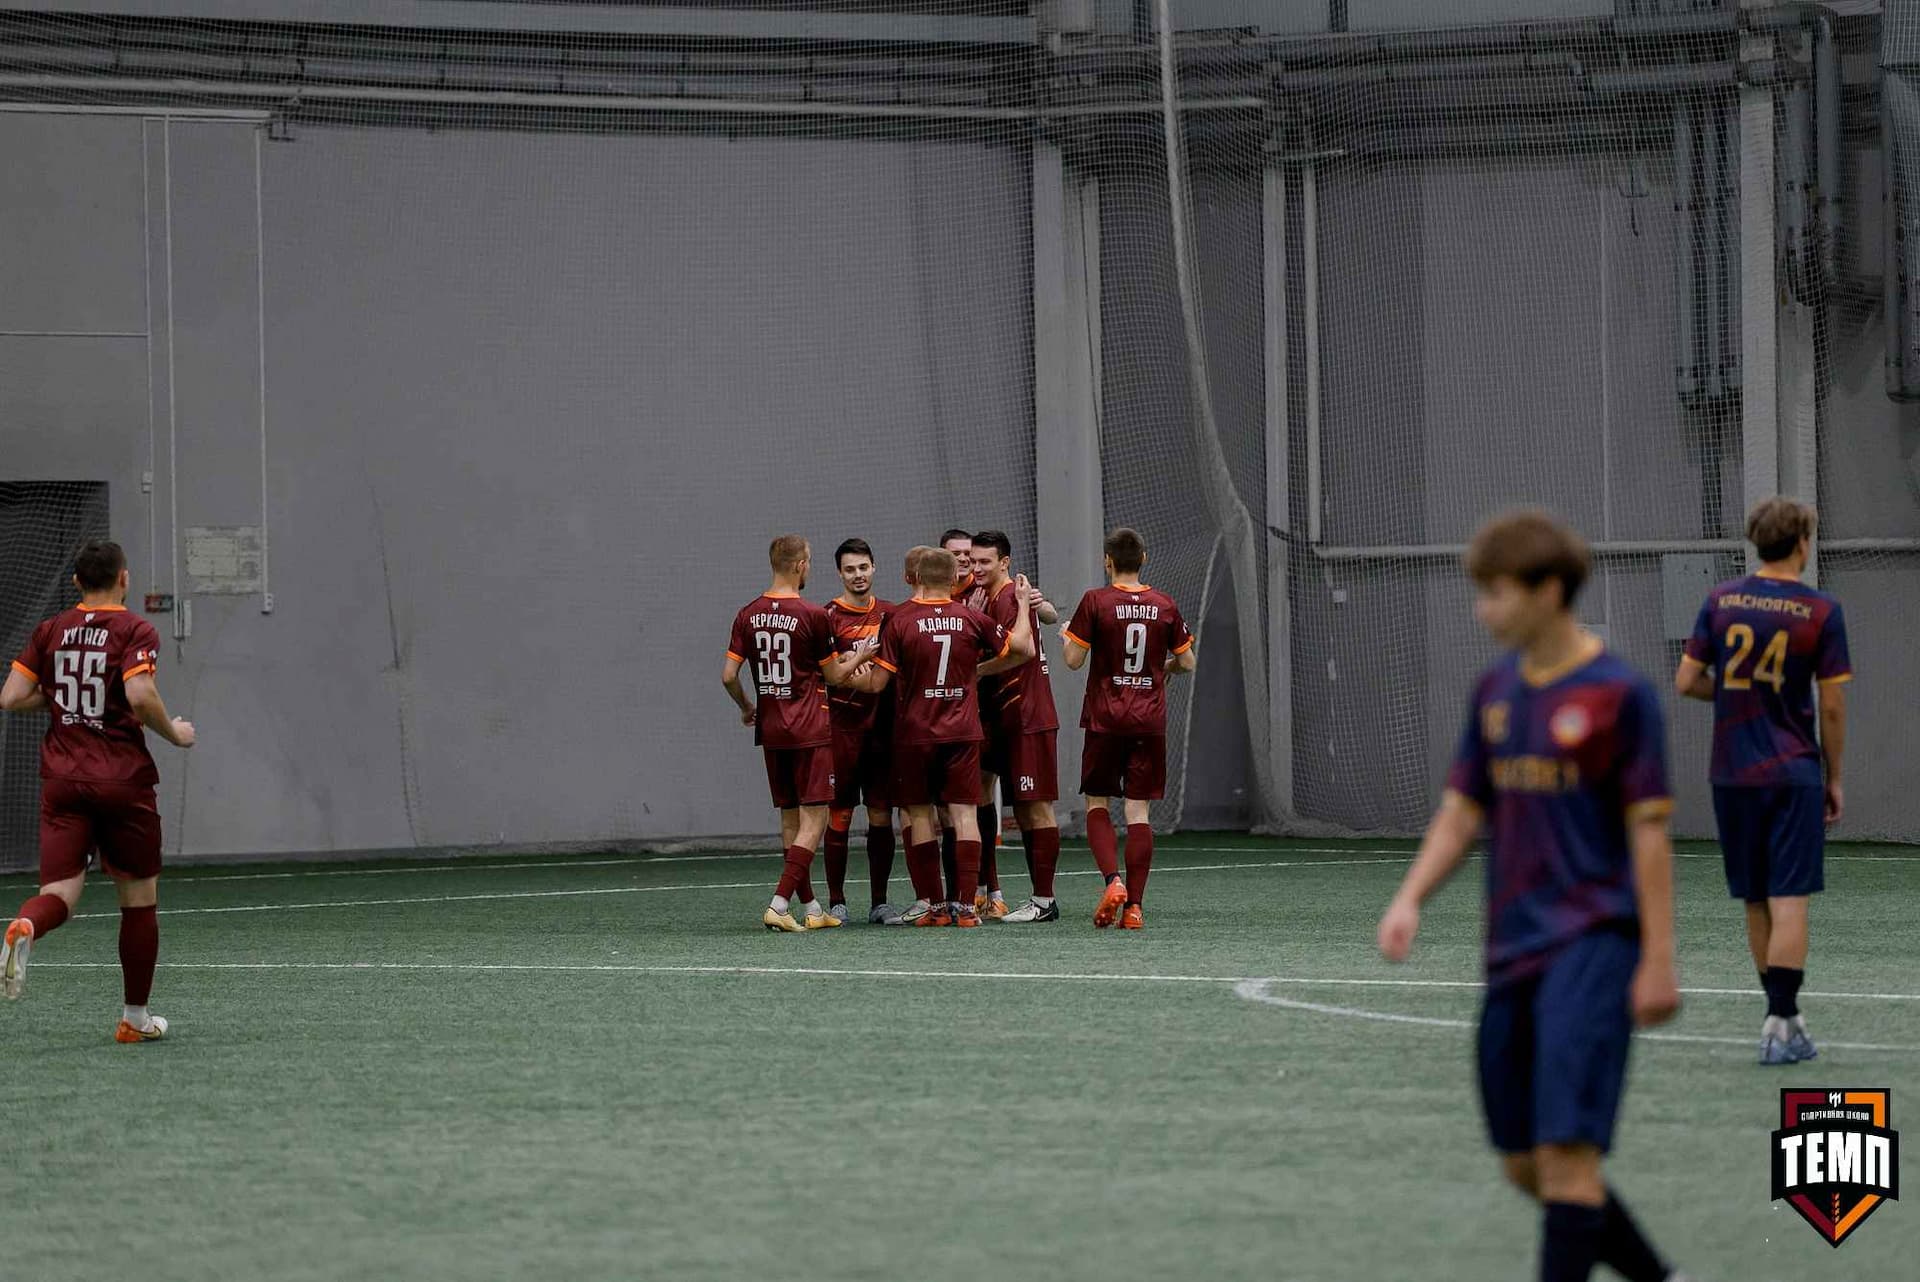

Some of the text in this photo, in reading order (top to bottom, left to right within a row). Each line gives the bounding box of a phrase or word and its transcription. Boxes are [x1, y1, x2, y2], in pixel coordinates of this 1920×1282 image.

[750, 612, 799, 632] ЧЕРКАСОВ
[1115, 604, 1159, 620] ШИБАЕВ
[916, 617, 963, 633] ЖДАНОВ
[755, 630, 792, 685] 33
[1123, 622, 1148, 674] 9
[932, 634, 952, 686] 7
[1723, 623, 1789, 694] 24
[54, 650, 107, 717] 55
[1112, 676, 1153, 686] SEUS
[924, 688, 964, 698] SEUS
[1020, 775, 1035, 792] 24
